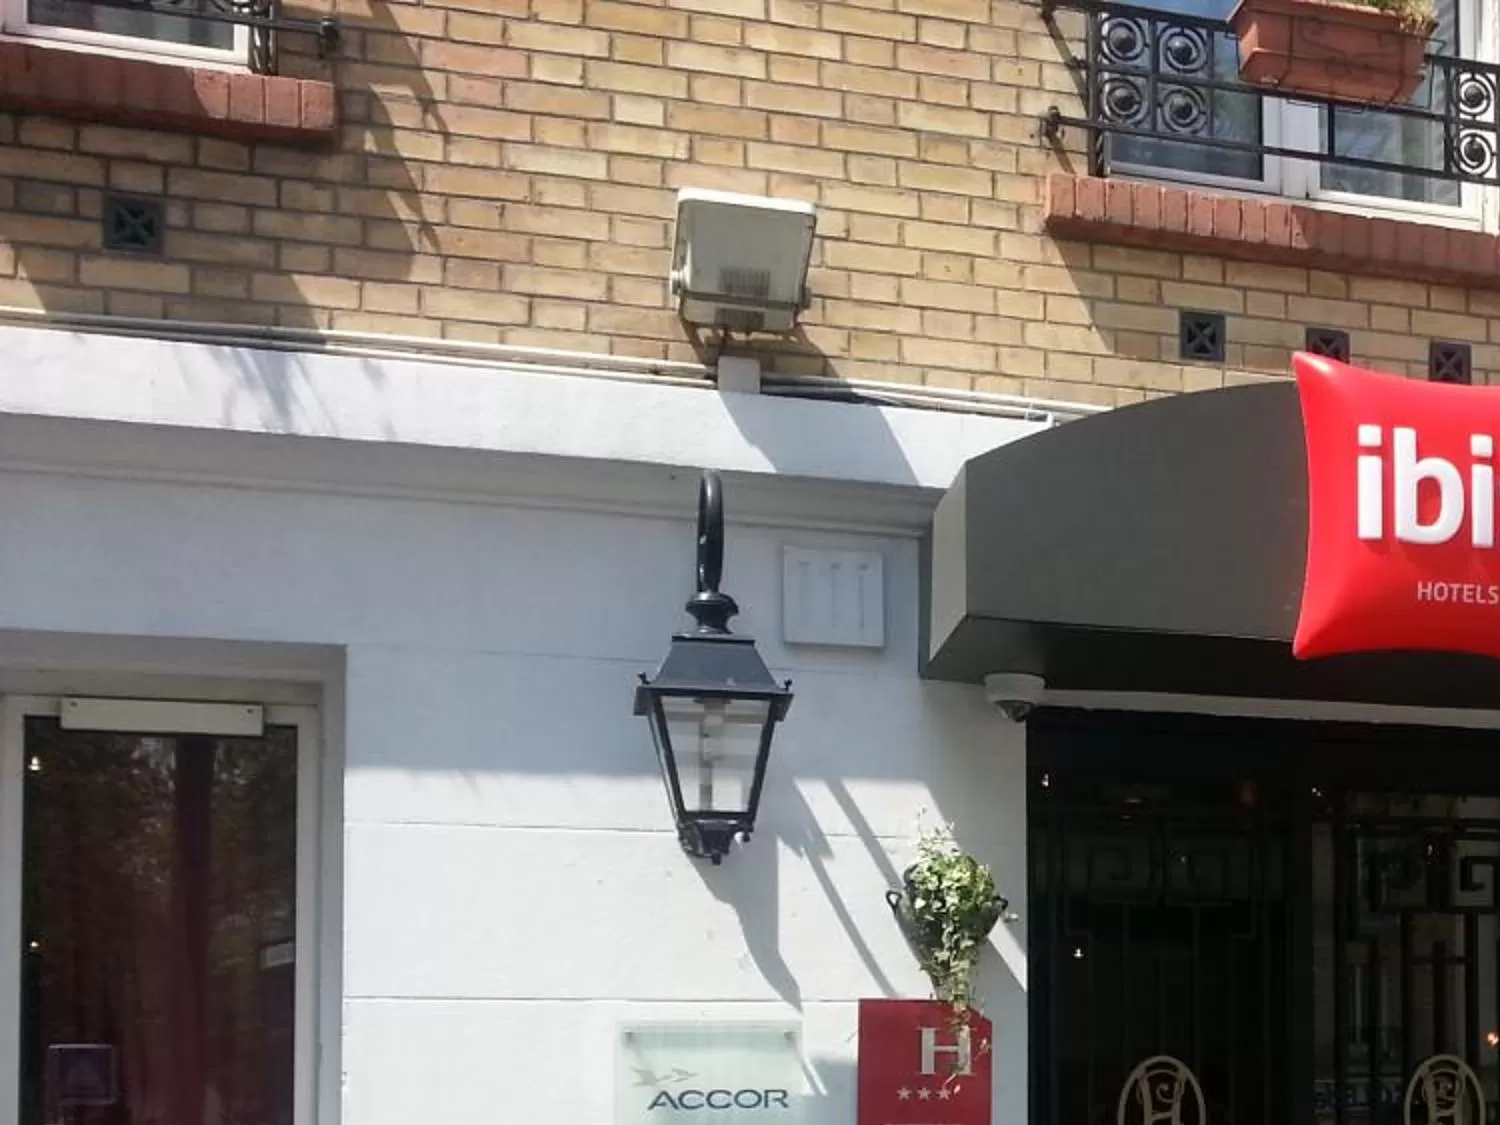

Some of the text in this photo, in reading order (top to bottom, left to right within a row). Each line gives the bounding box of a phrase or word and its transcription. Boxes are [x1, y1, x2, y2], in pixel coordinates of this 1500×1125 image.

[1416, 580, 1500, 606] HOTELS
[917, 1027, 976, 1076] H
[647, 1088, 790, 1111] ACCOR
